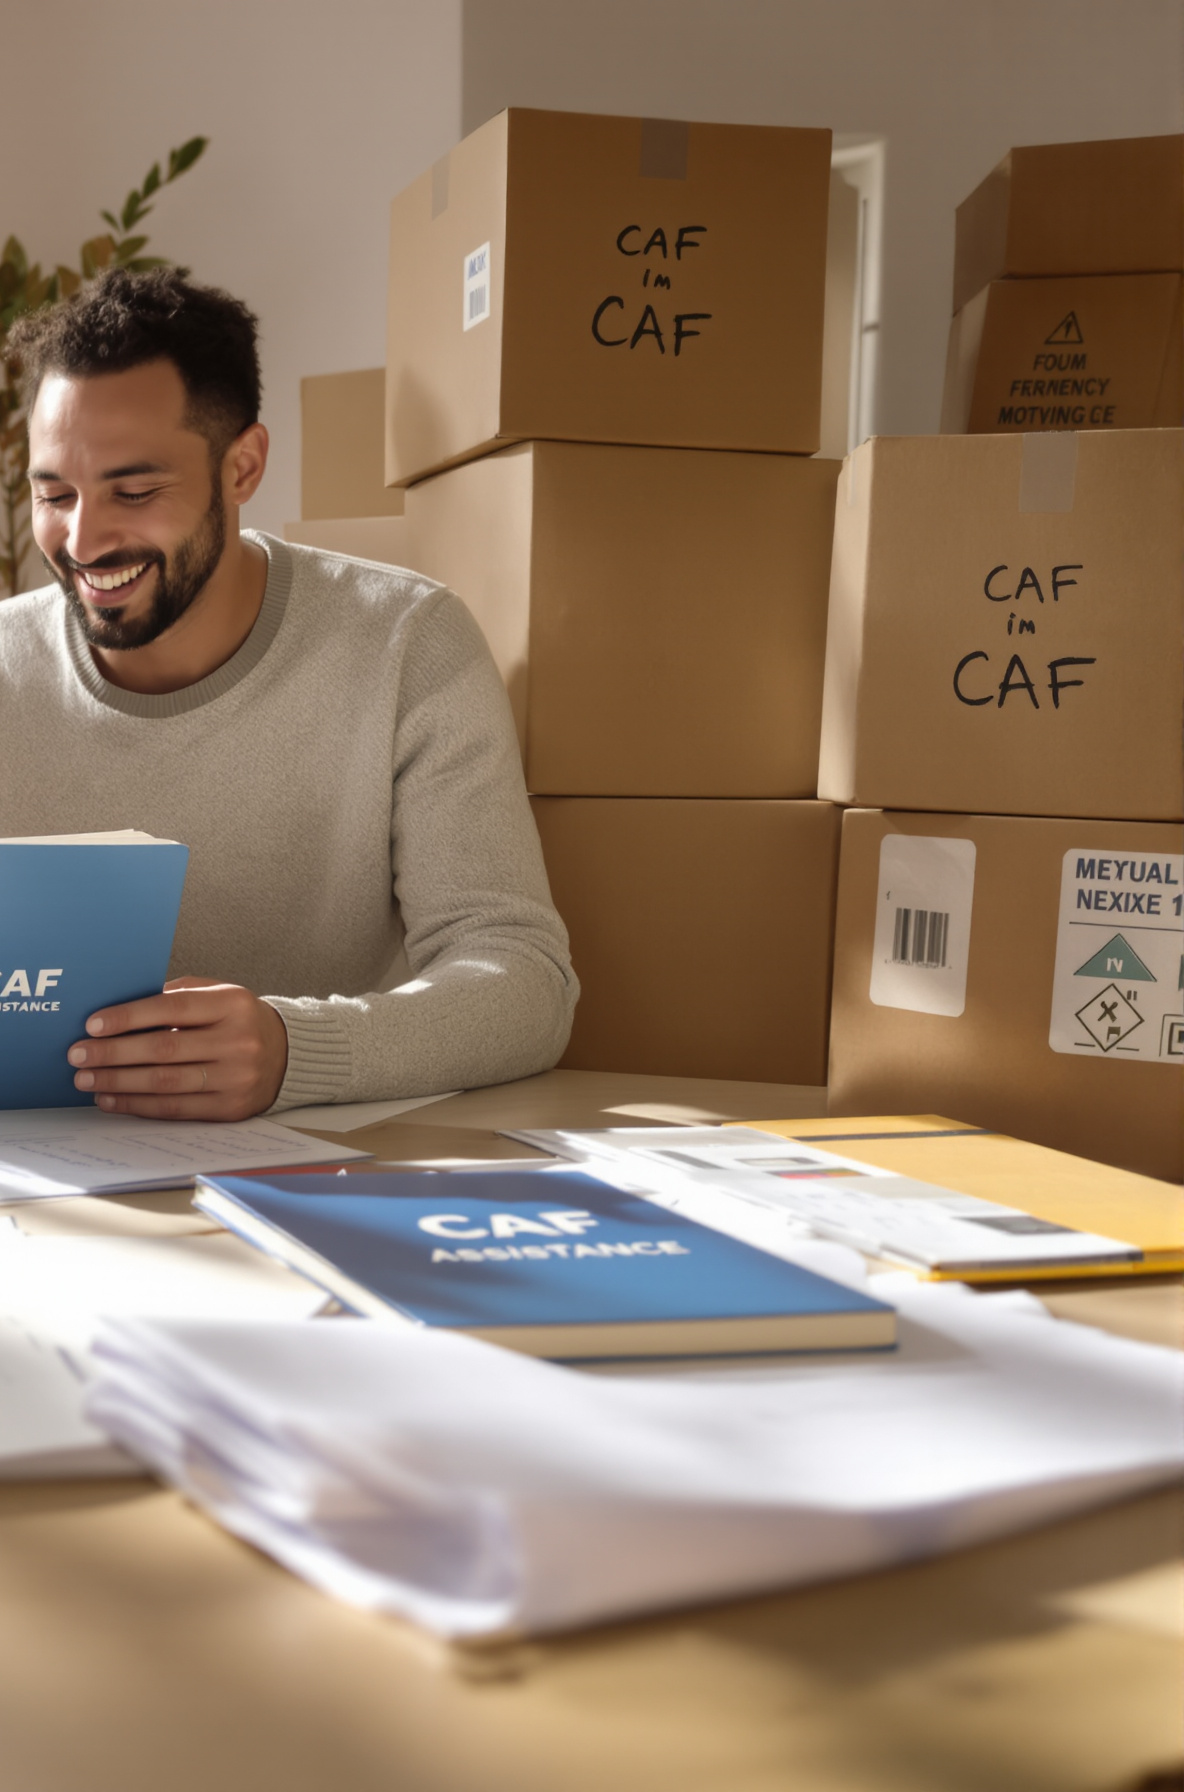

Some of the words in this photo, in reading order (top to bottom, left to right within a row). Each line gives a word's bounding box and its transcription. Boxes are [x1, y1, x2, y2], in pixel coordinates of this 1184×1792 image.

[617, 225, 708, 261] CAF
[591, 295, 713, 357] CAF
[984, 564, 1084, 604] CAF
[953, 650, 1097, 710] CAF
[1075, 857, 1179, 885] MEYUAL
[1076, 888, 1162, 915] NEXIXE
[417, 1210, 600, 1240] CAF
[430, 1240, 692, 1264] ASSISTANCE
